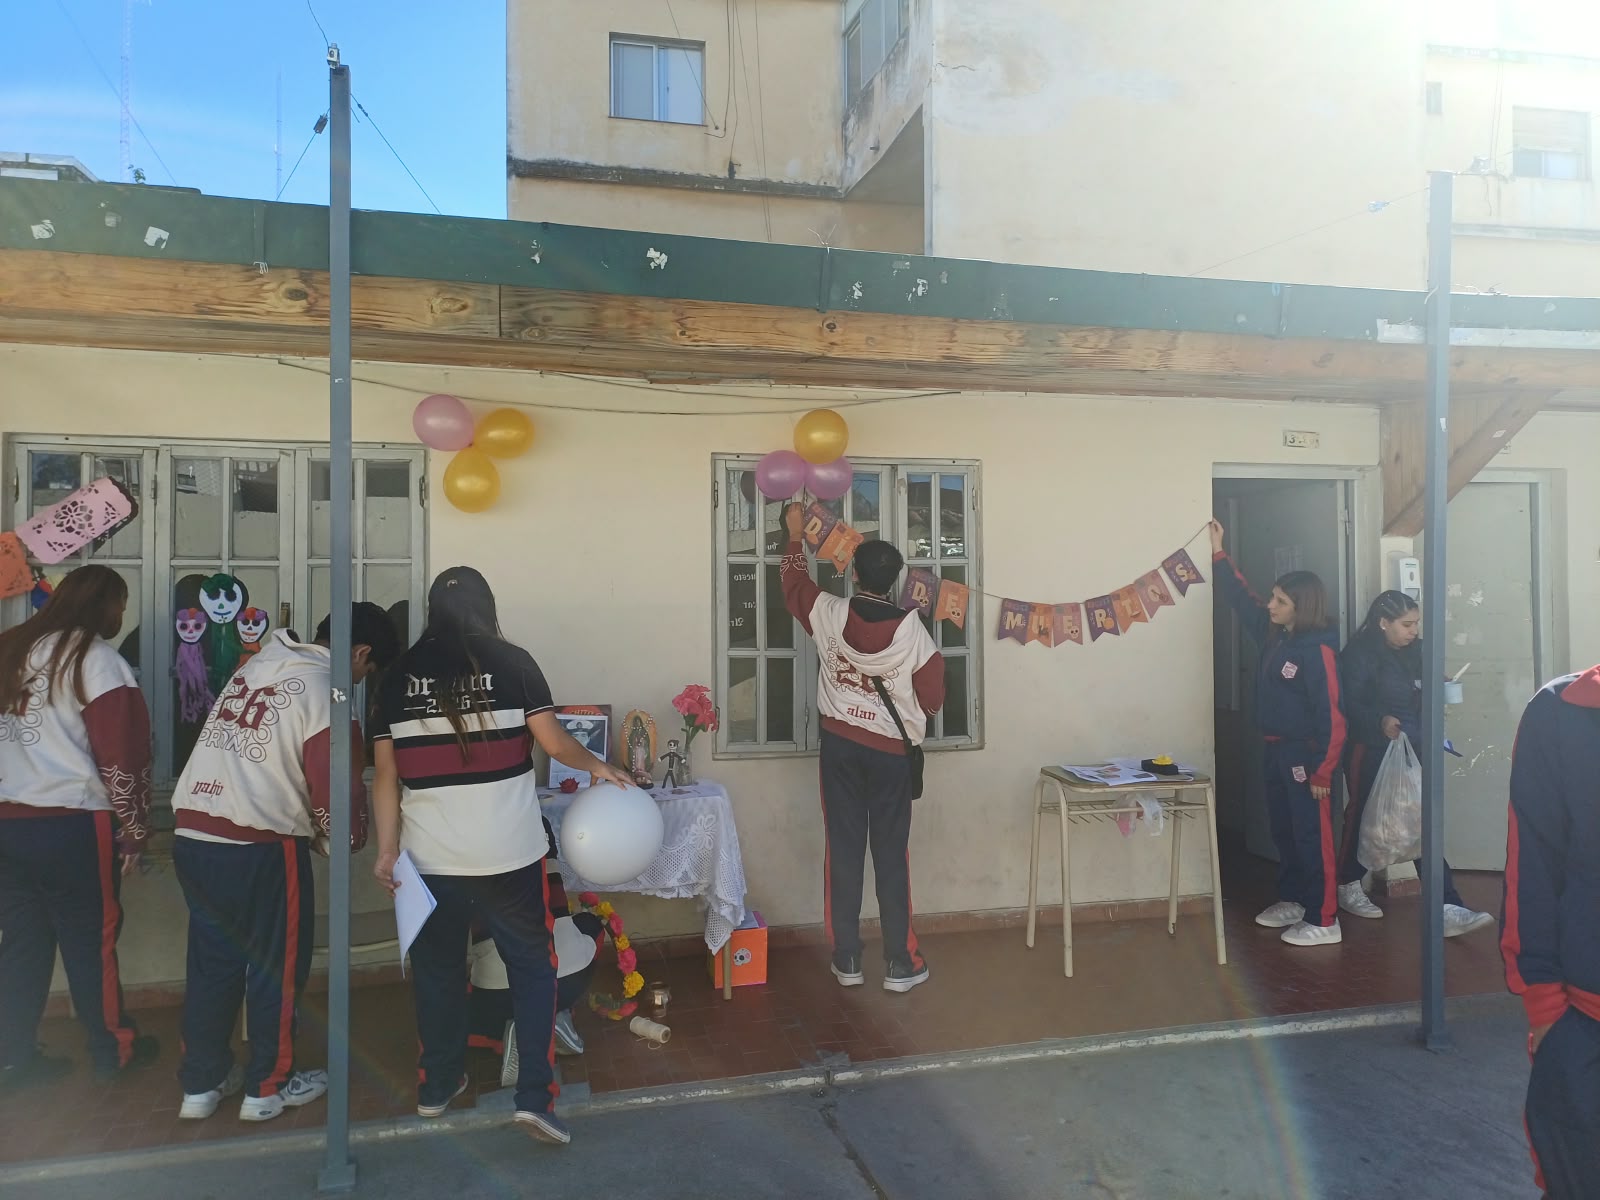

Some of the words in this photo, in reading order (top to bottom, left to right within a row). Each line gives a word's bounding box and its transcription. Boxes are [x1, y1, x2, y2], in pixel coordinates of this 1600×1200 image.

[912, 581, 960, 612] DE
[426, 695, 471, 713] 26
[846, 705, 877, 721] alan
